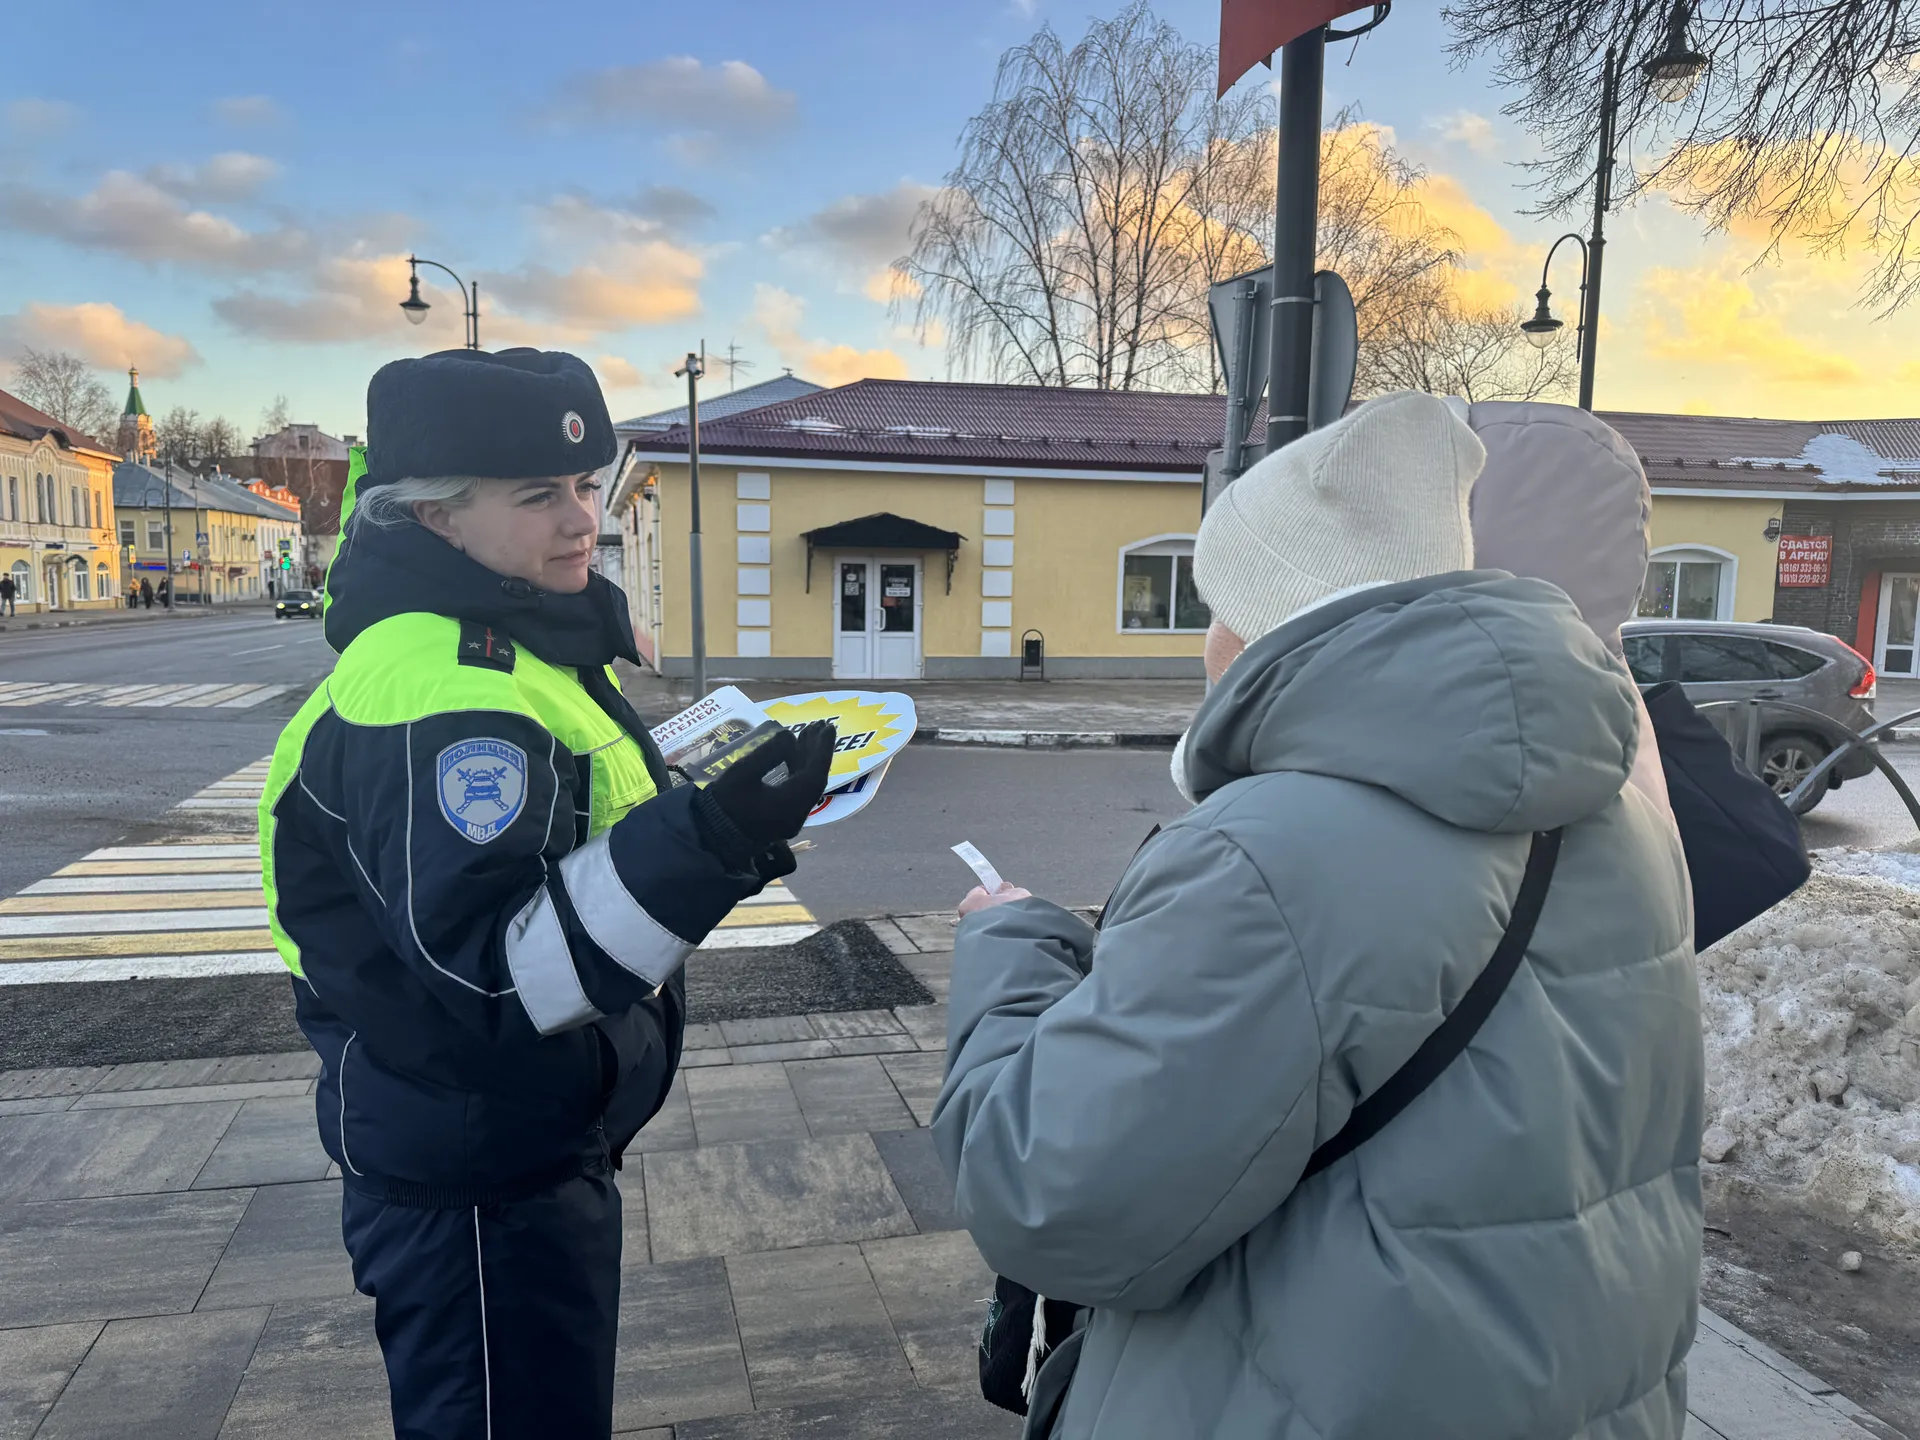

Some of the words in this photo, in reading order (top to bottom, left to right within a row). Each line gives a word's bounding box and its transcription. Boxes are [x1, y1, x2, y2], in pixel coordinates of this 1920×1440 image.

[1780, 550, 1786, 560] В
[1789, 551, 1829, 561] АРЕНДУ
[656, 704, 722, 745] ИТЕЛЕЙ!
[443, 743, 521, 769] ПОЛИЦИЯ
[466, 821, 498, 841] МВД
